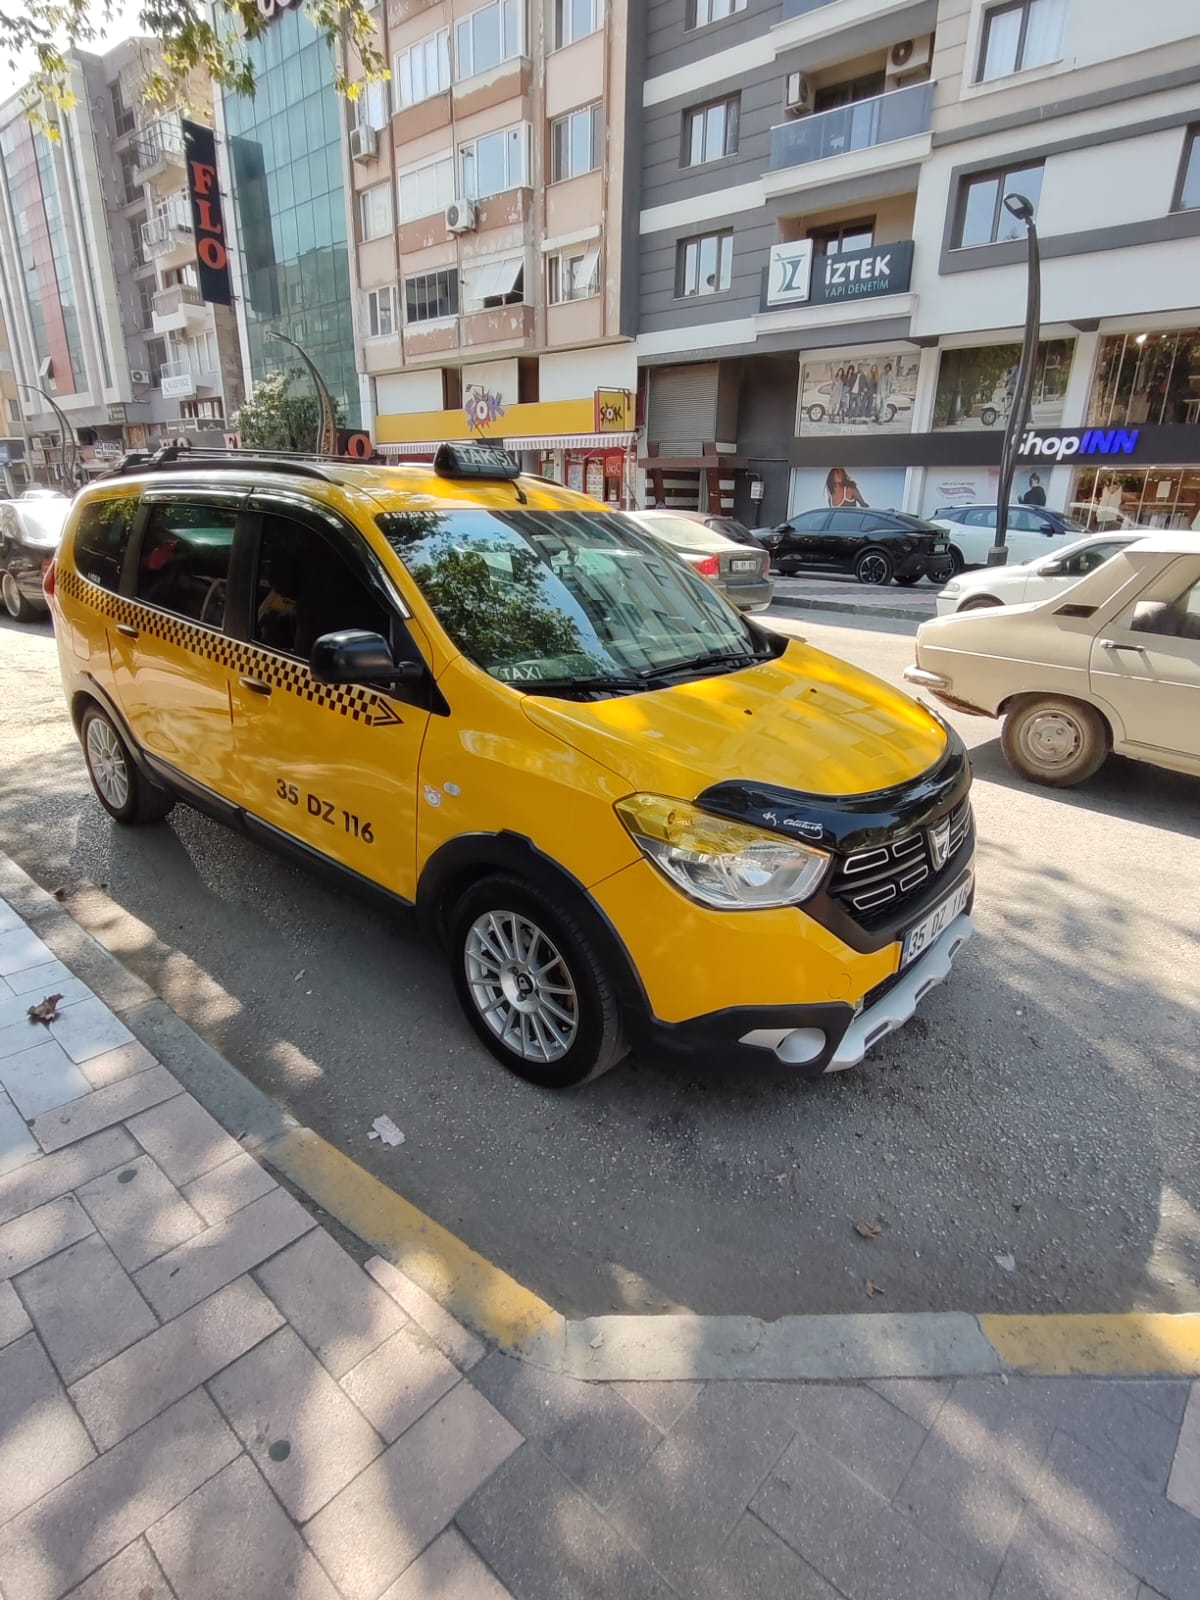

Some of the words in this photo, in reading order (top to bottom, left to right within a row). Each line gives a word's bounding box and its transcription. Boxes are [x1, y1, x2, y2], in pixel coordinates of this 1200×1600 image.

[190, 161, 227, 270] FLO
[825, 254, 892, 285] İZTEK
[825, 284, 846, 298] YAPI
[848, 278, 889, 295] DENETİM
[499, 666, 544, 681] TAXI
[276, 778, 299, 806] 35
[307, 793, 336, 826] DZ
[342, 810, 375, 845] 116
[909, 923, 928, 957] 35
